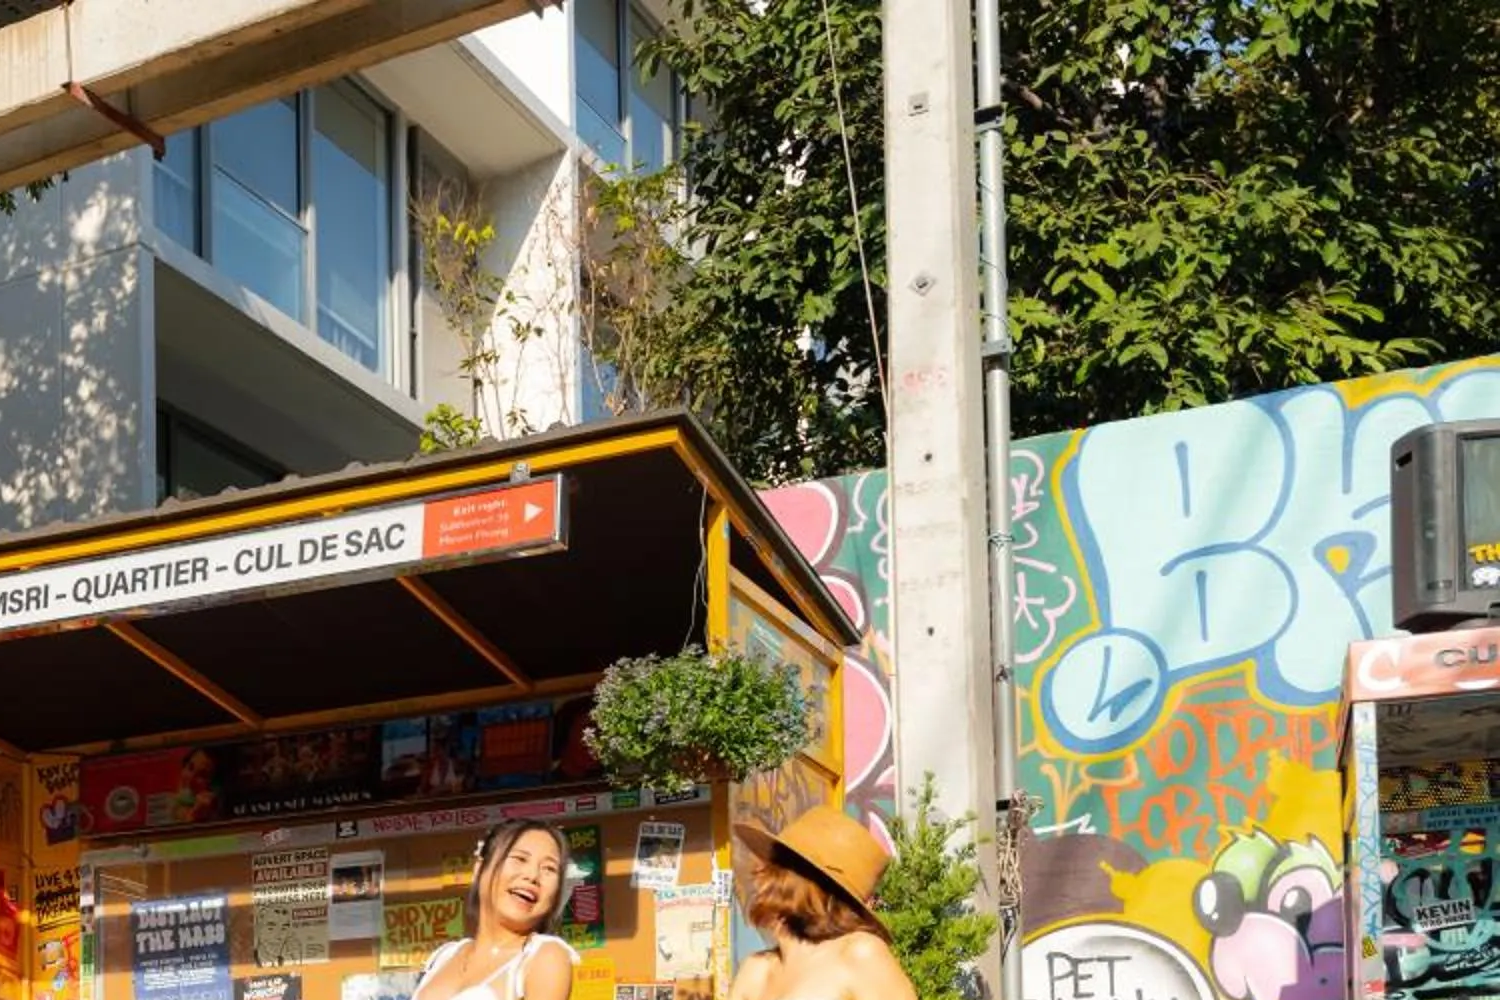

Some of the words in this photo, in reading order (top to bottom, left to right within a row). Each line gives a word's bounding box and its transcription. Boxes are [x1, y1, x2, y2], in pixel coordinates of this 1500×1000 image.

[72, 557, 209, 605] QUARTIER
[234, 543, 292, 576] CUL
[299, 533, 338, 566] DE
[344, 523, 406, 557] SAC
[254, 853, 292, 867] ADVERT
[295, 848, 328, 861] SPACE
[385, 908, 420, 930] DID
[421, 900, 460, 924] YOU
[1416, 899, 1471, 921] KEVIN
[135, 929, 175, 954] THE
